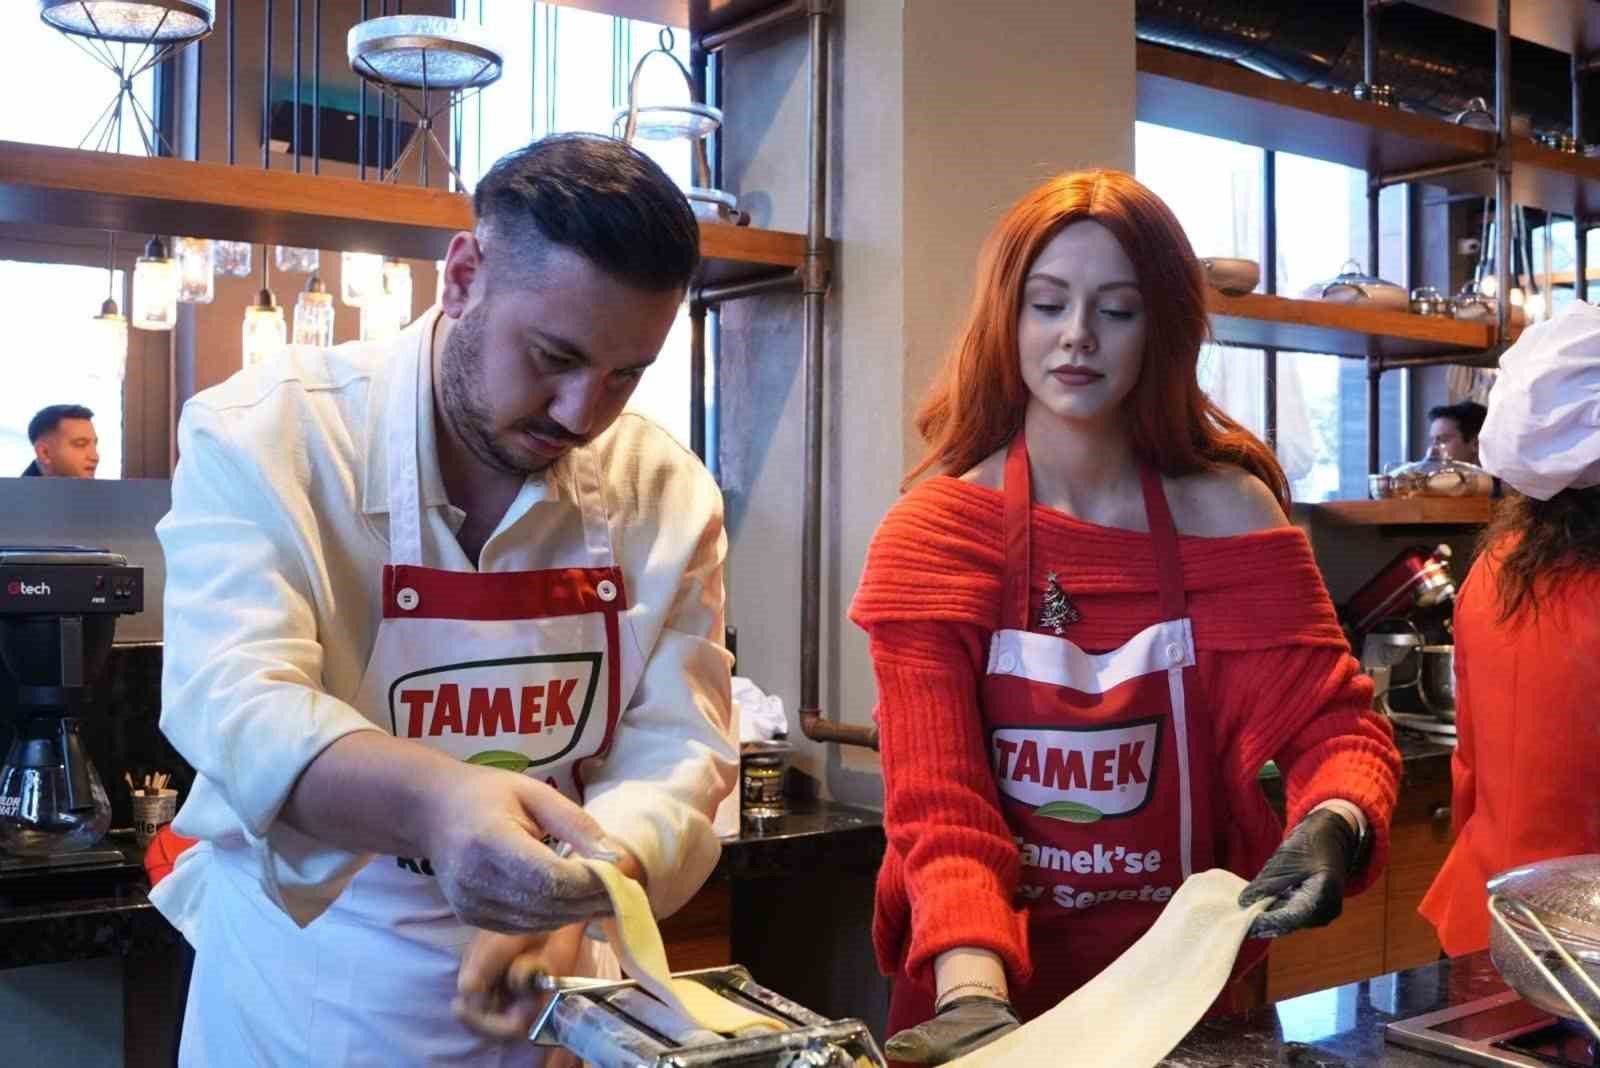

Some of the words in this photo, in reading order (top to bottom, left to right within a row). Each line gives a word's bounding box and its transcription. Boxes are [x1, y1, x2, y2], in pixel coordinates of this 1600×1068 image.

[401, 679, 579, 738] TAMEK
[996, 739, 1148, 791] TAMEK
[1015, 836, 1161, 874] amek'se
